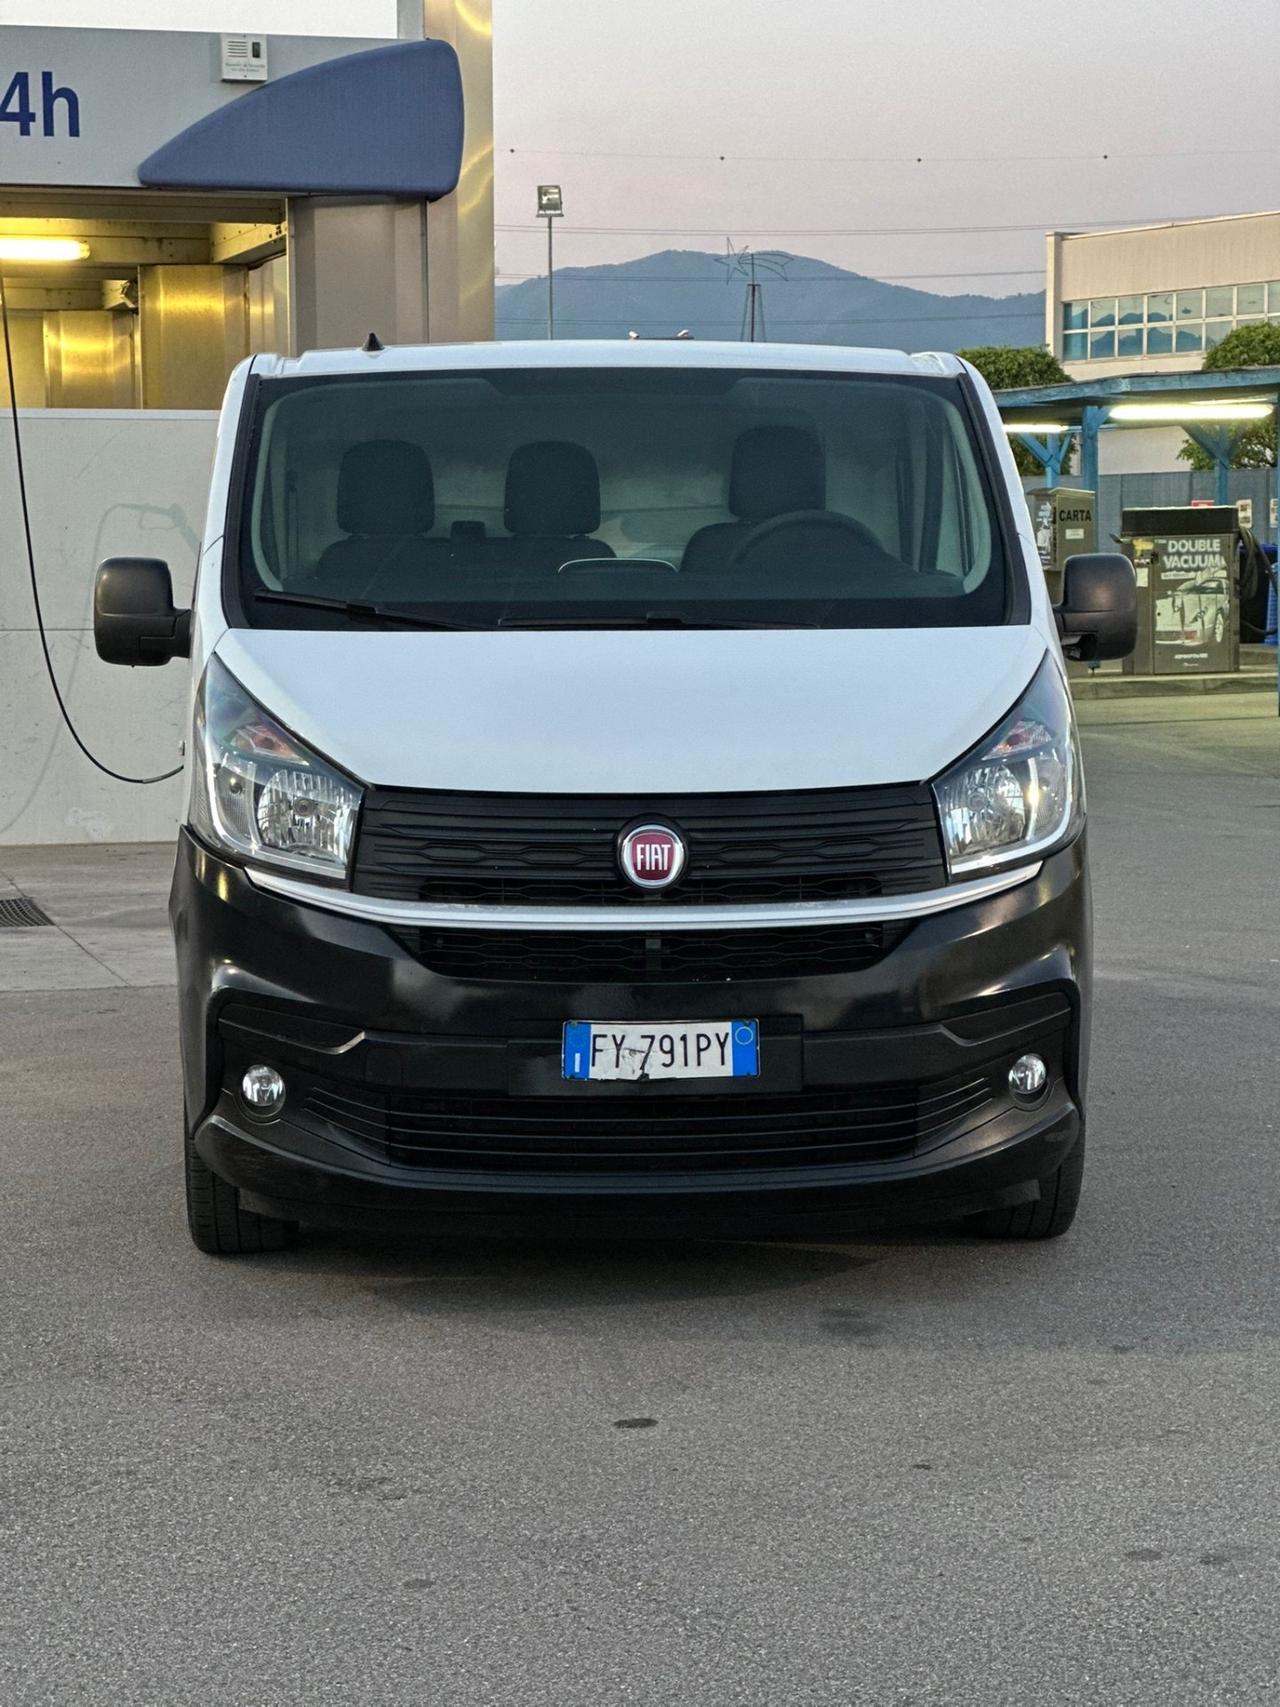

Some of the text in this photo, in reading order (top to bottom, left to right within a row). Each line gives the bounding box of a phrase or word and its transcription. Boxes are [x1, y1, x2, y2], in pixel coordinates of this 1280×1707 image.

[0, 71, 80, 137] 4h
[1059, 509, 1092, 522] CARTA
[1168, 539, 1221, 553] DOUBLE
[1163, 554, 1221, 569] VACUUM
[636, 843, 671, 871] FIAT
